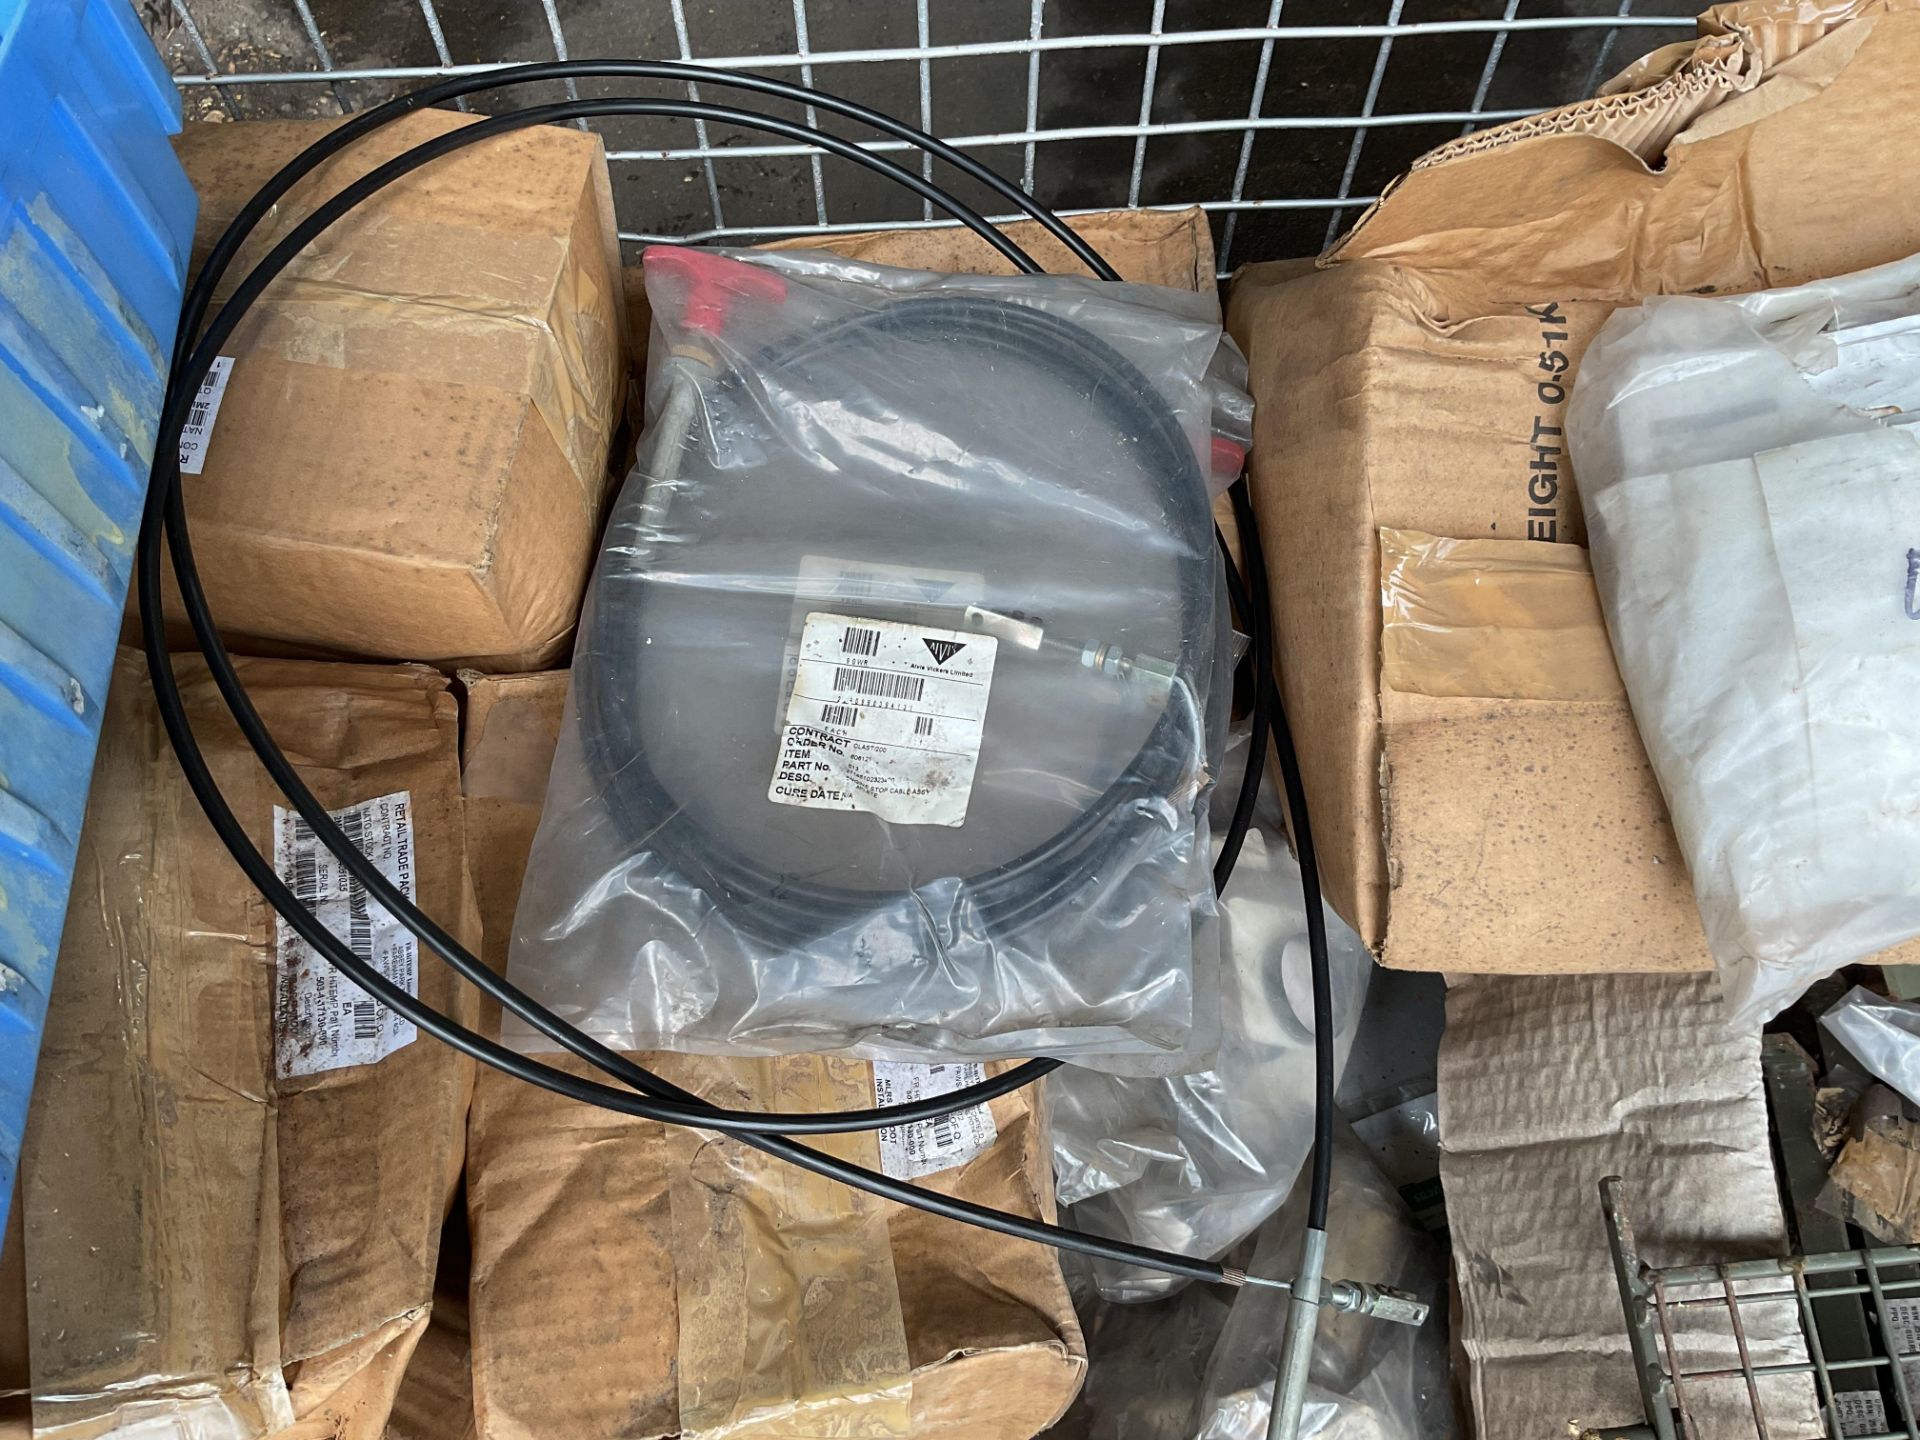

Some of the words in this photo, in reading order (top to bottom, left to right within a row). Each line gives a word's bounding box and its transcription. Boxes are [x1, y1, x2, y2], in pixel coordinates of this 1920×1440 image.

[183, 426, 203, 435] NAT
[1527, 416, 1561, 542] EIGHT
[927, 665, 949, 674] Vickers
[950, 669, 973, 677] Limited
[789, 727, 851, 748] CONTRACT
[784, 749, 811, 759] ITEM
[782, 760, 812, 770] PART
[814, 762, 831, 771] No.
[775, 786, 807, 798] CURE
[889, 786, 911, 795] CABLE
[363, 807, 372, 830] NATO
[380, 803, 391, 846] CONTRACT
[394, 803, 406, 838] RETAIL
[364, 831, 374, 858] STOCK
[397, 840, 409, 871] TRADE
[319, 864, 328, 893] SERIAL
[328, 976, 338, 1008] HiTEMP
[342, 1002, 352, 1016] EA
[375, 1009, 384, 1021] OF
[885, 1079, 893, 1103] MLRS
